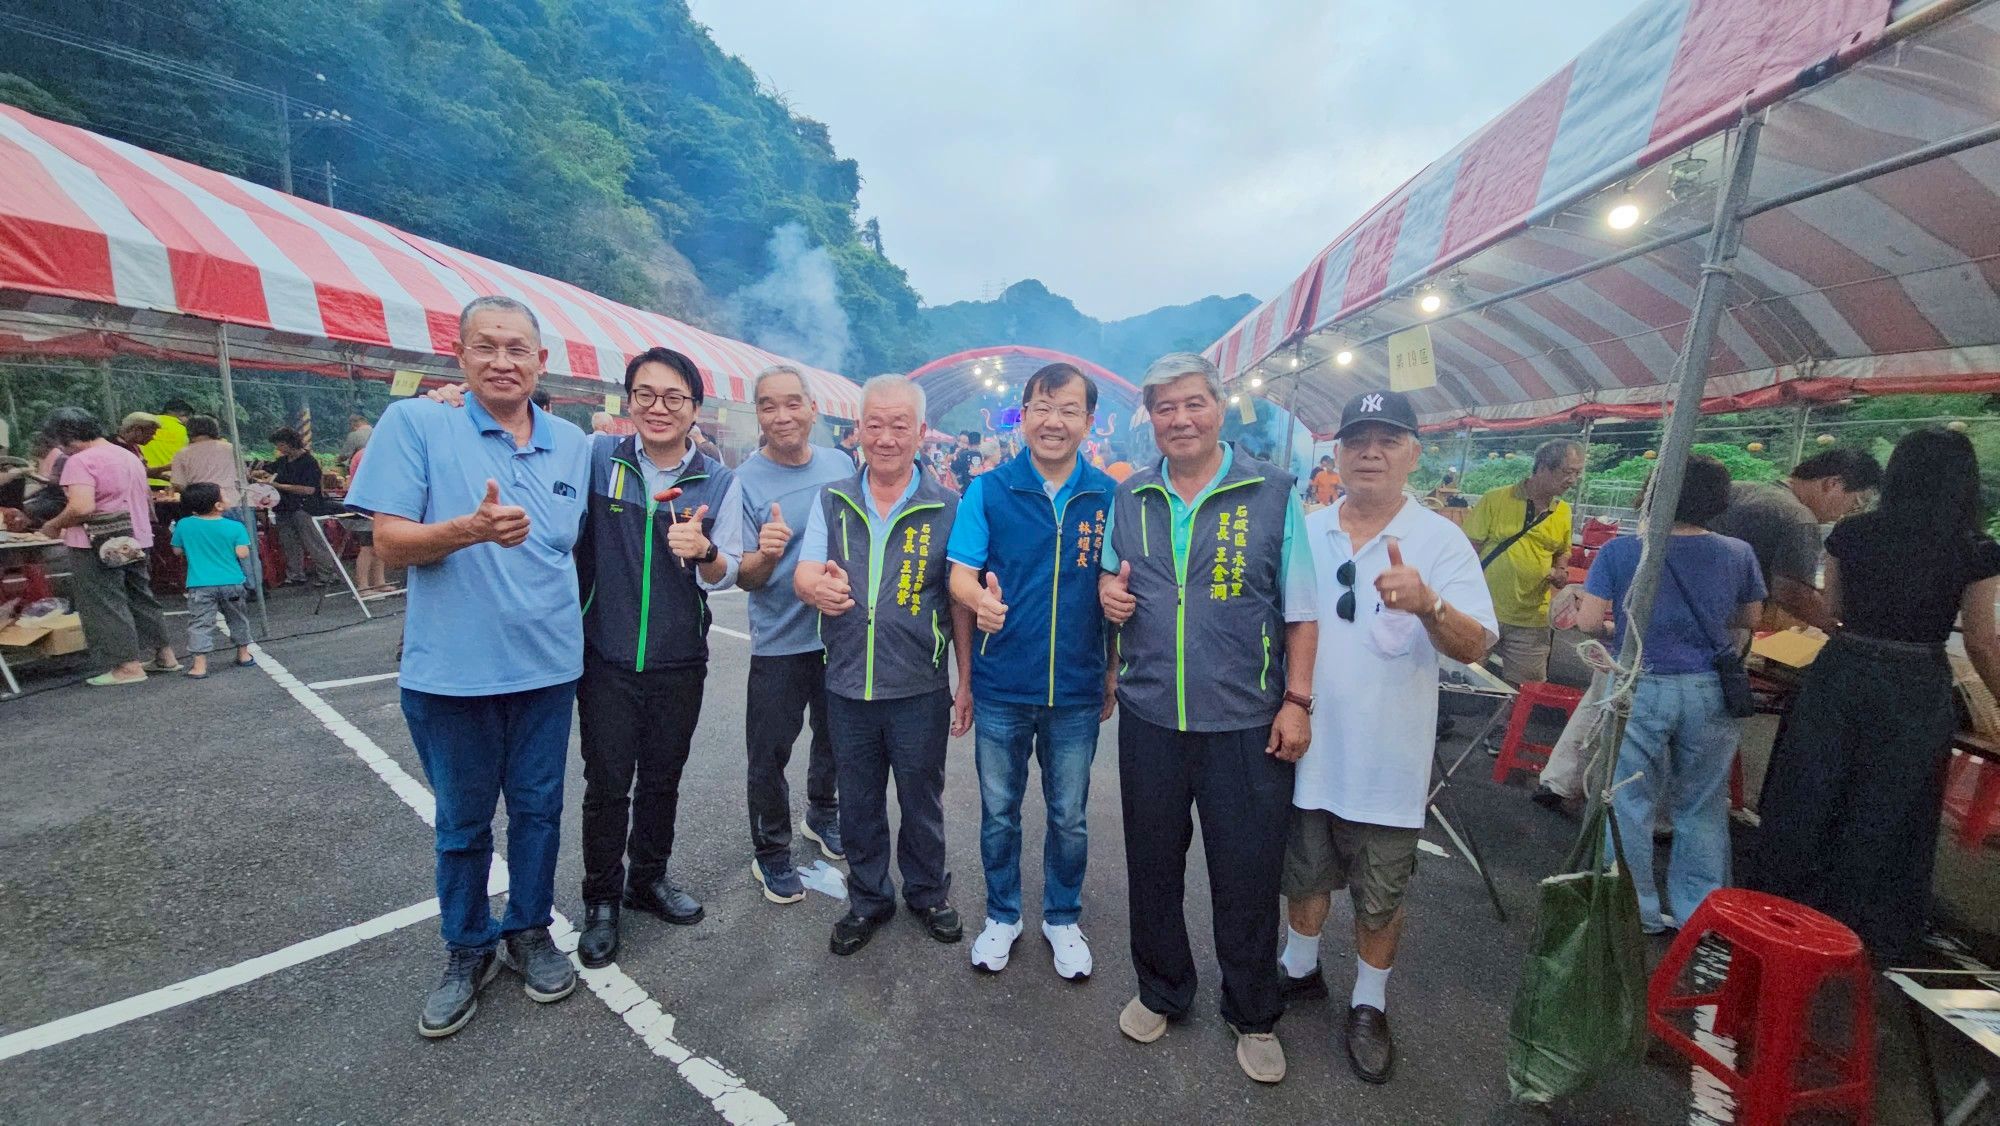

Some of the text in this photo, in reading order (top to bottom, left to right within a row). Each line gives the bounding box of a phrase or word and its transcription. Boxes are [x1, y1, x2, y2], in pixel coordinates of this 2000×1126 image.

[1360, 393, 1384, 413] NY
[902, 526, 918, 554] 會長
[1076, 520, 1092, 568] 林耀長
